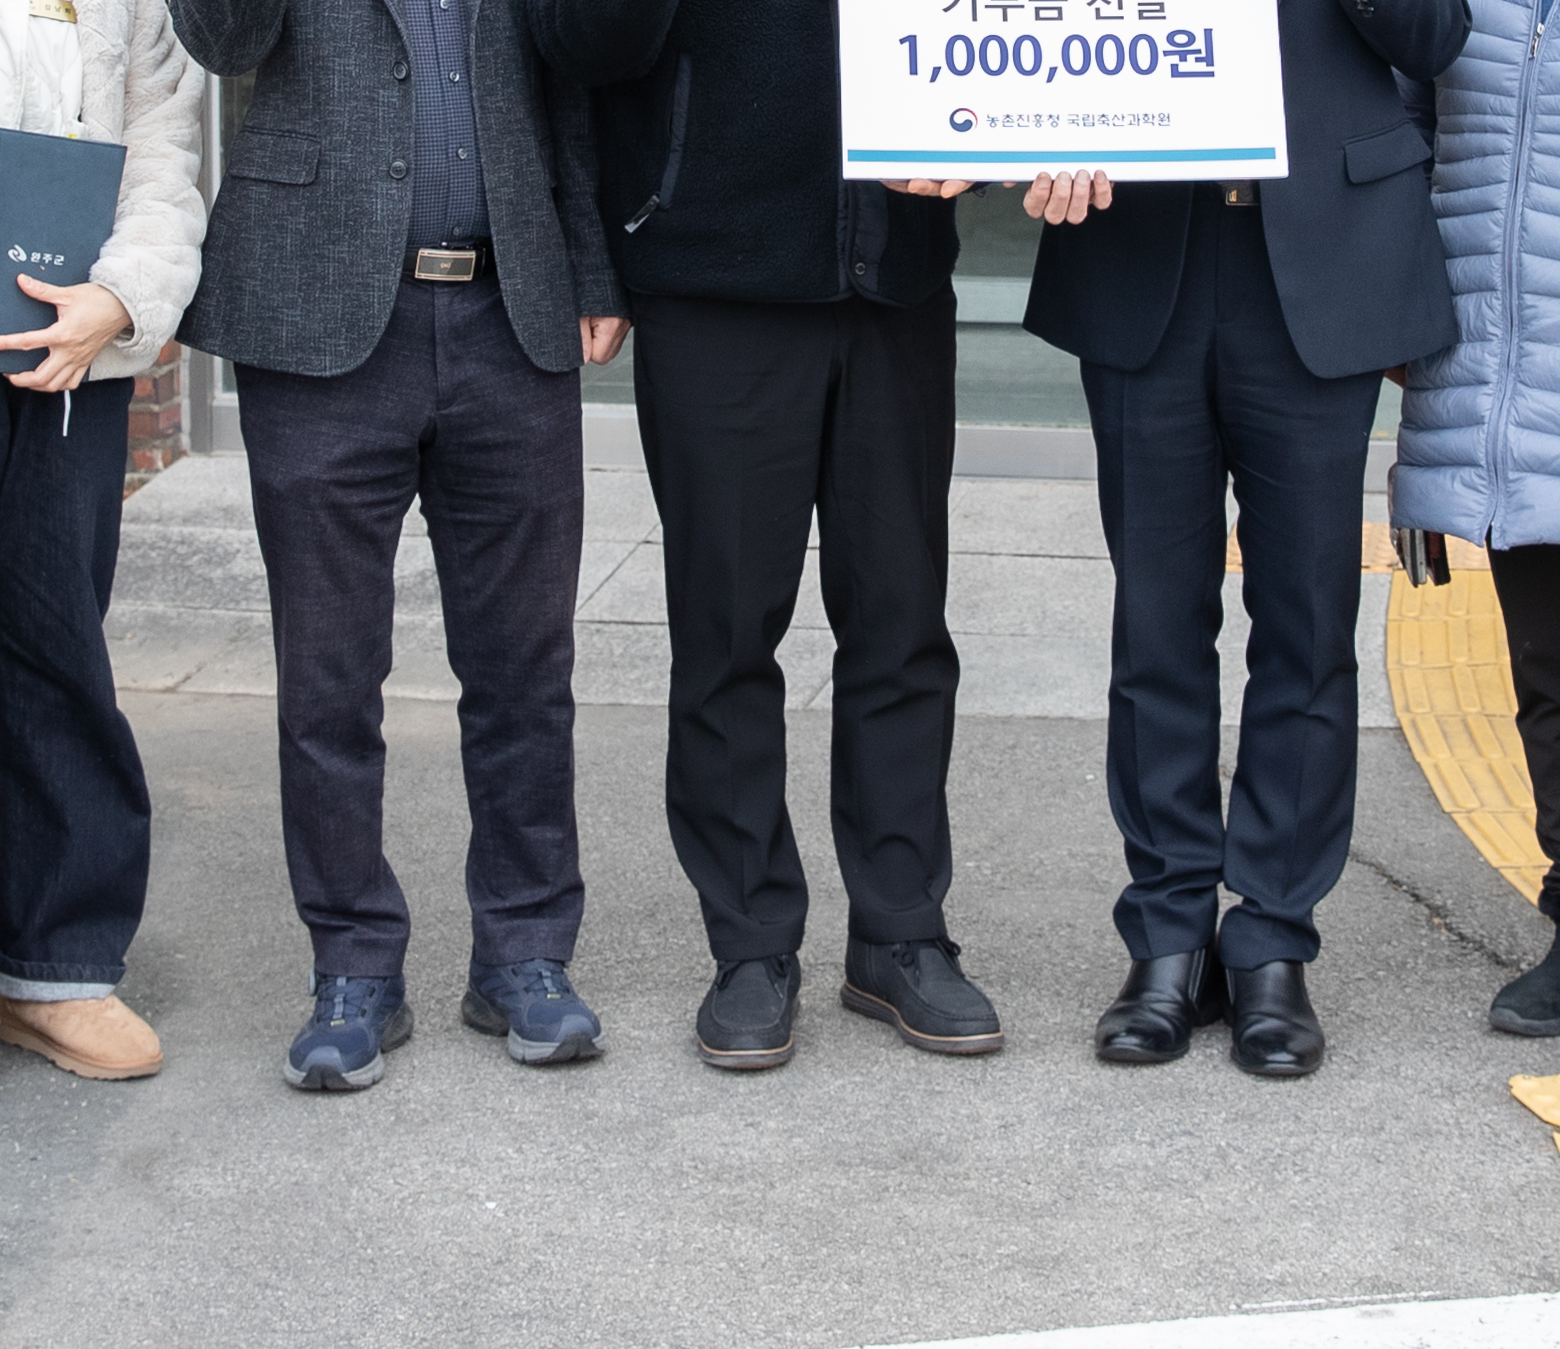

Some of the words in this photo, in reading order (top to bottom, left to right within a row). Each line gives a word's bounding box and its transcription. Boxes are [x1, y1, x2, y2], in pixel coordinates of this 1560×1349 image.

[897, 27, 1217, 84] 1,000,000원
[985, 111, 1061, 129] 농촌진흥청
[1065, 111, 1172, 129] 국립축산과학원
